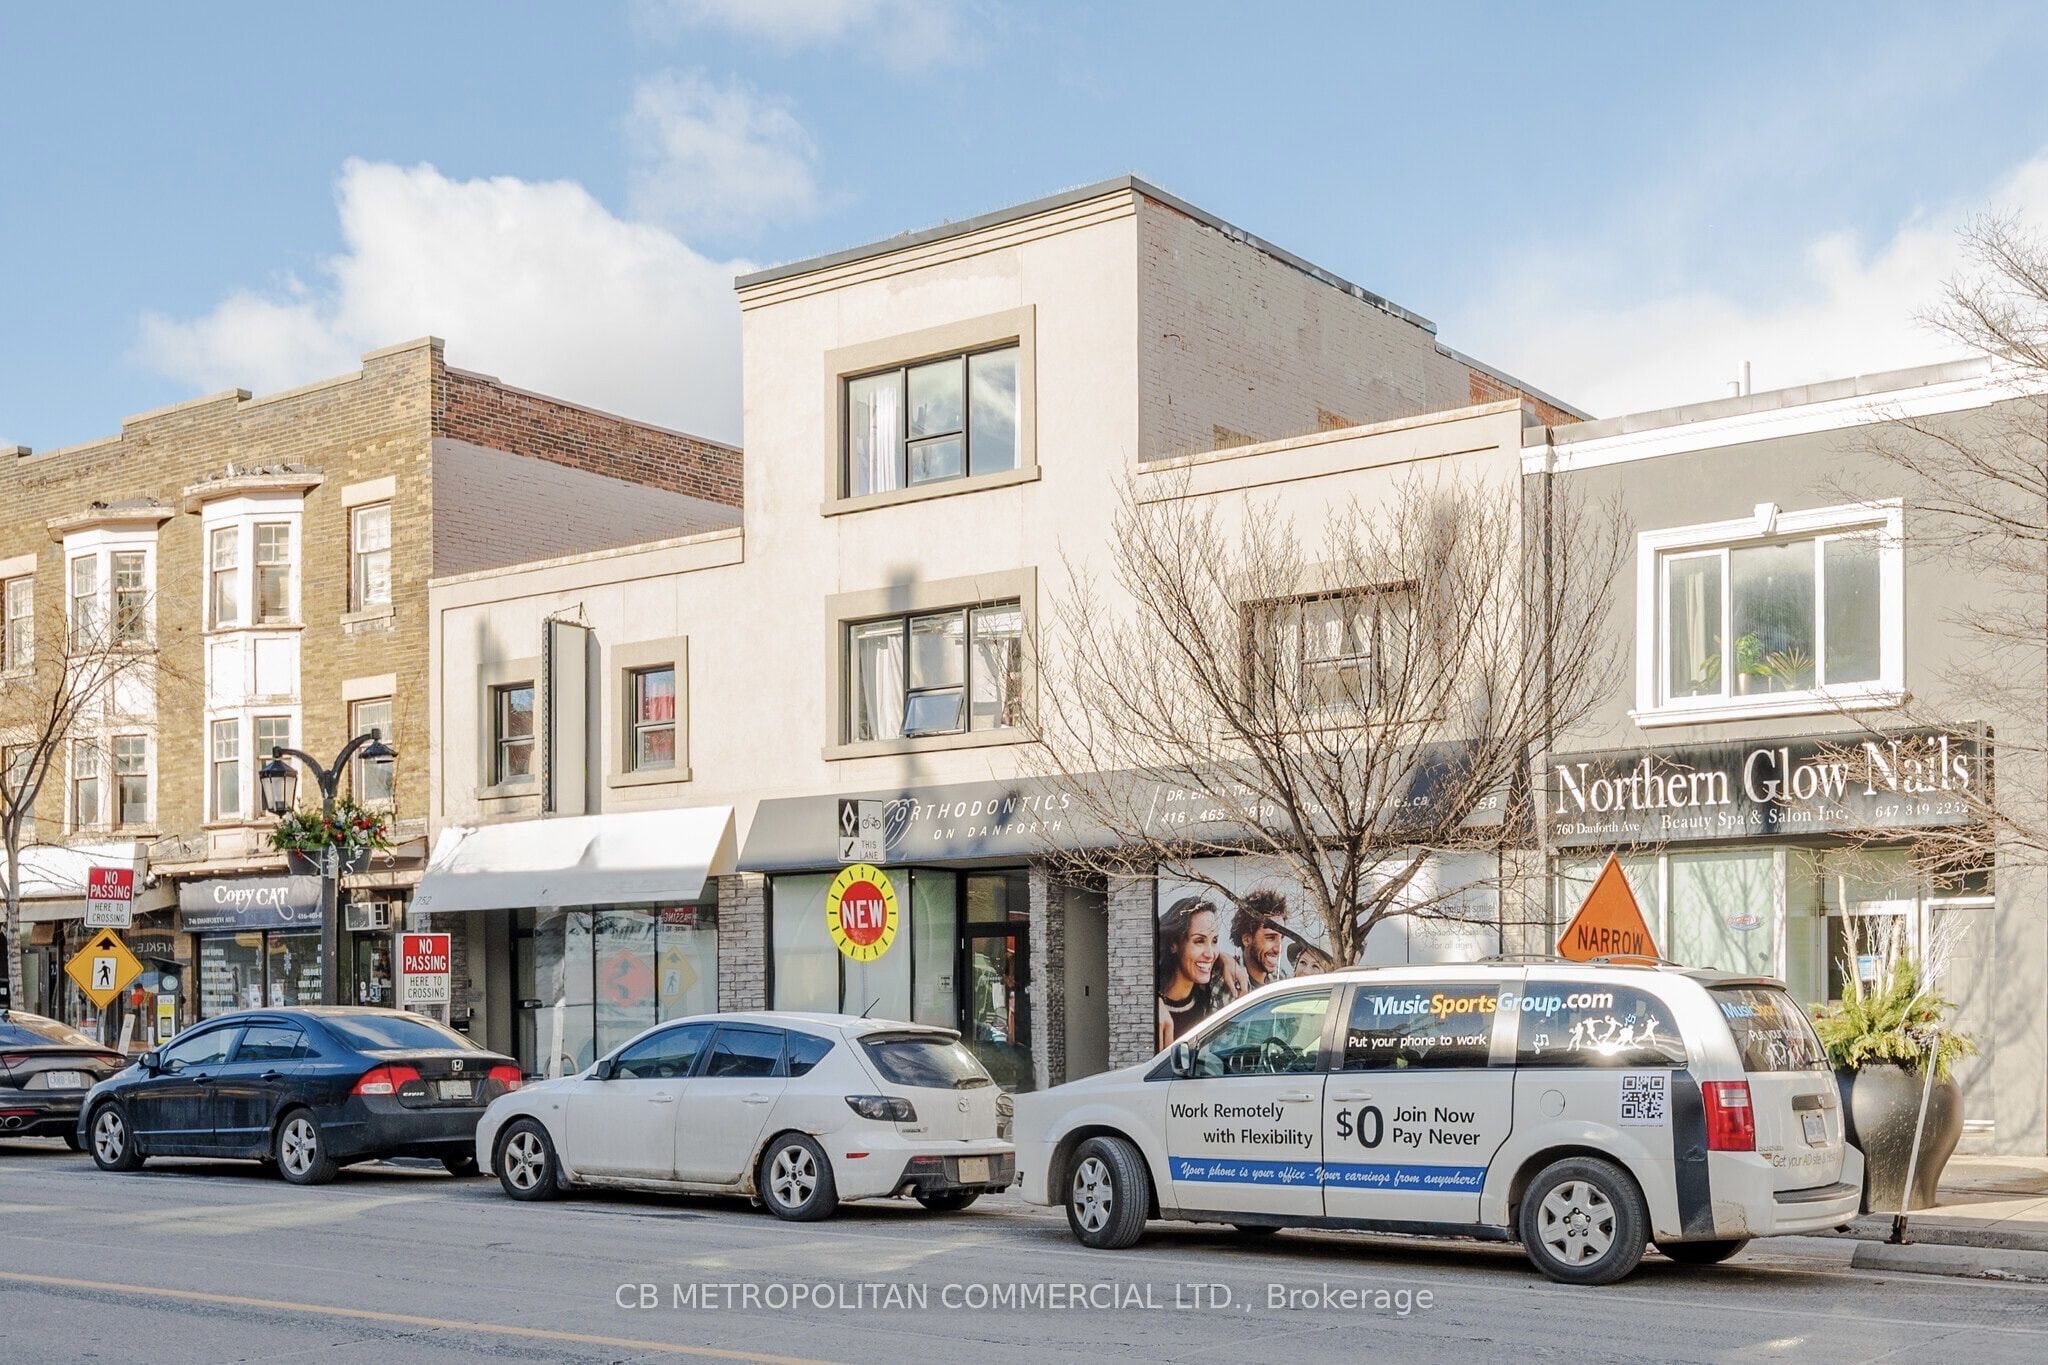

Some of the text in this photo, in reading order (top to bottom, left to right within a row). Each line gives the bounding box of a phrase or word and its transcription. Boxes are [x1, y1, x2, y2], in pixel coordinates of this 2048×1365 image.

[1555, 735, 1969, 814] Northern Glow Nails
[1166, 789, 1186, 802] DR.
[895, 793, 1071, 823] ORTHODONTICS
[1199, 808, 1226, 822] 465
[1661, 814, 1713, 830] Beauty
[1717, 811, 1745, 829] Spa
[1750, 809, 1763, 825] &
[1768, 805, 1812, 825] Salon
[1818, 805, 1850, 821] Inc.
[1875, 805, 1900, 818] 647
[934, 819, 1063, 840] ON DANFORTH
[1556, 821, 1640, 835] 760 Danforth Ave
[861, 840, 877, 849] THIS
[860, 852, 879, 860] LANE
[104, 870, 118, 885] NO
[90, 884, 131, 900] PASSING
[94, 903, 124, 912] HERE TO
[255, 887, 294, 920] CAT
[92, 913, 125, 923] CROSSING
[841, 899, 883, 929] NEW
[419, 939, 433, 955] NO
[1577, 924, 1644, 955] NARROW
[405, 955, 447, 972] PASSING
[410, 976, 443, 986] HERE TO
[407, 987, 445, 999] CROSSING
[1373, 992, 1614, 1019] MusicSportsGroup.com
[1349, 1034, 1488, 1049] Put your phone to work
[1748, 1029, 1766, 1041] Put
[1170, 1102, 1285, 1122] Work Remotely
[1392, 1106, 1475, 1124] Join Now
[1336, 1105, 1384, 1149] $0
[1203, 1128, 1314, 1150] with Flexibility
[1392, 1128, 1481, 1149] Pay Never
[1180, 1161, 1205, 1180] Your
[1207, 1163, 1236, 1179] phone
[1239, 1167, 1249, 1178] is
[1252, 1168, 1275, 1181] your
[1277, 1166, 1306, 1184] office
[1344, 1171, 1391, 1187] earnings
[1393, 1169, 1421, 1187] from
[1423, 1171, 1484, 1188] anywhere!
